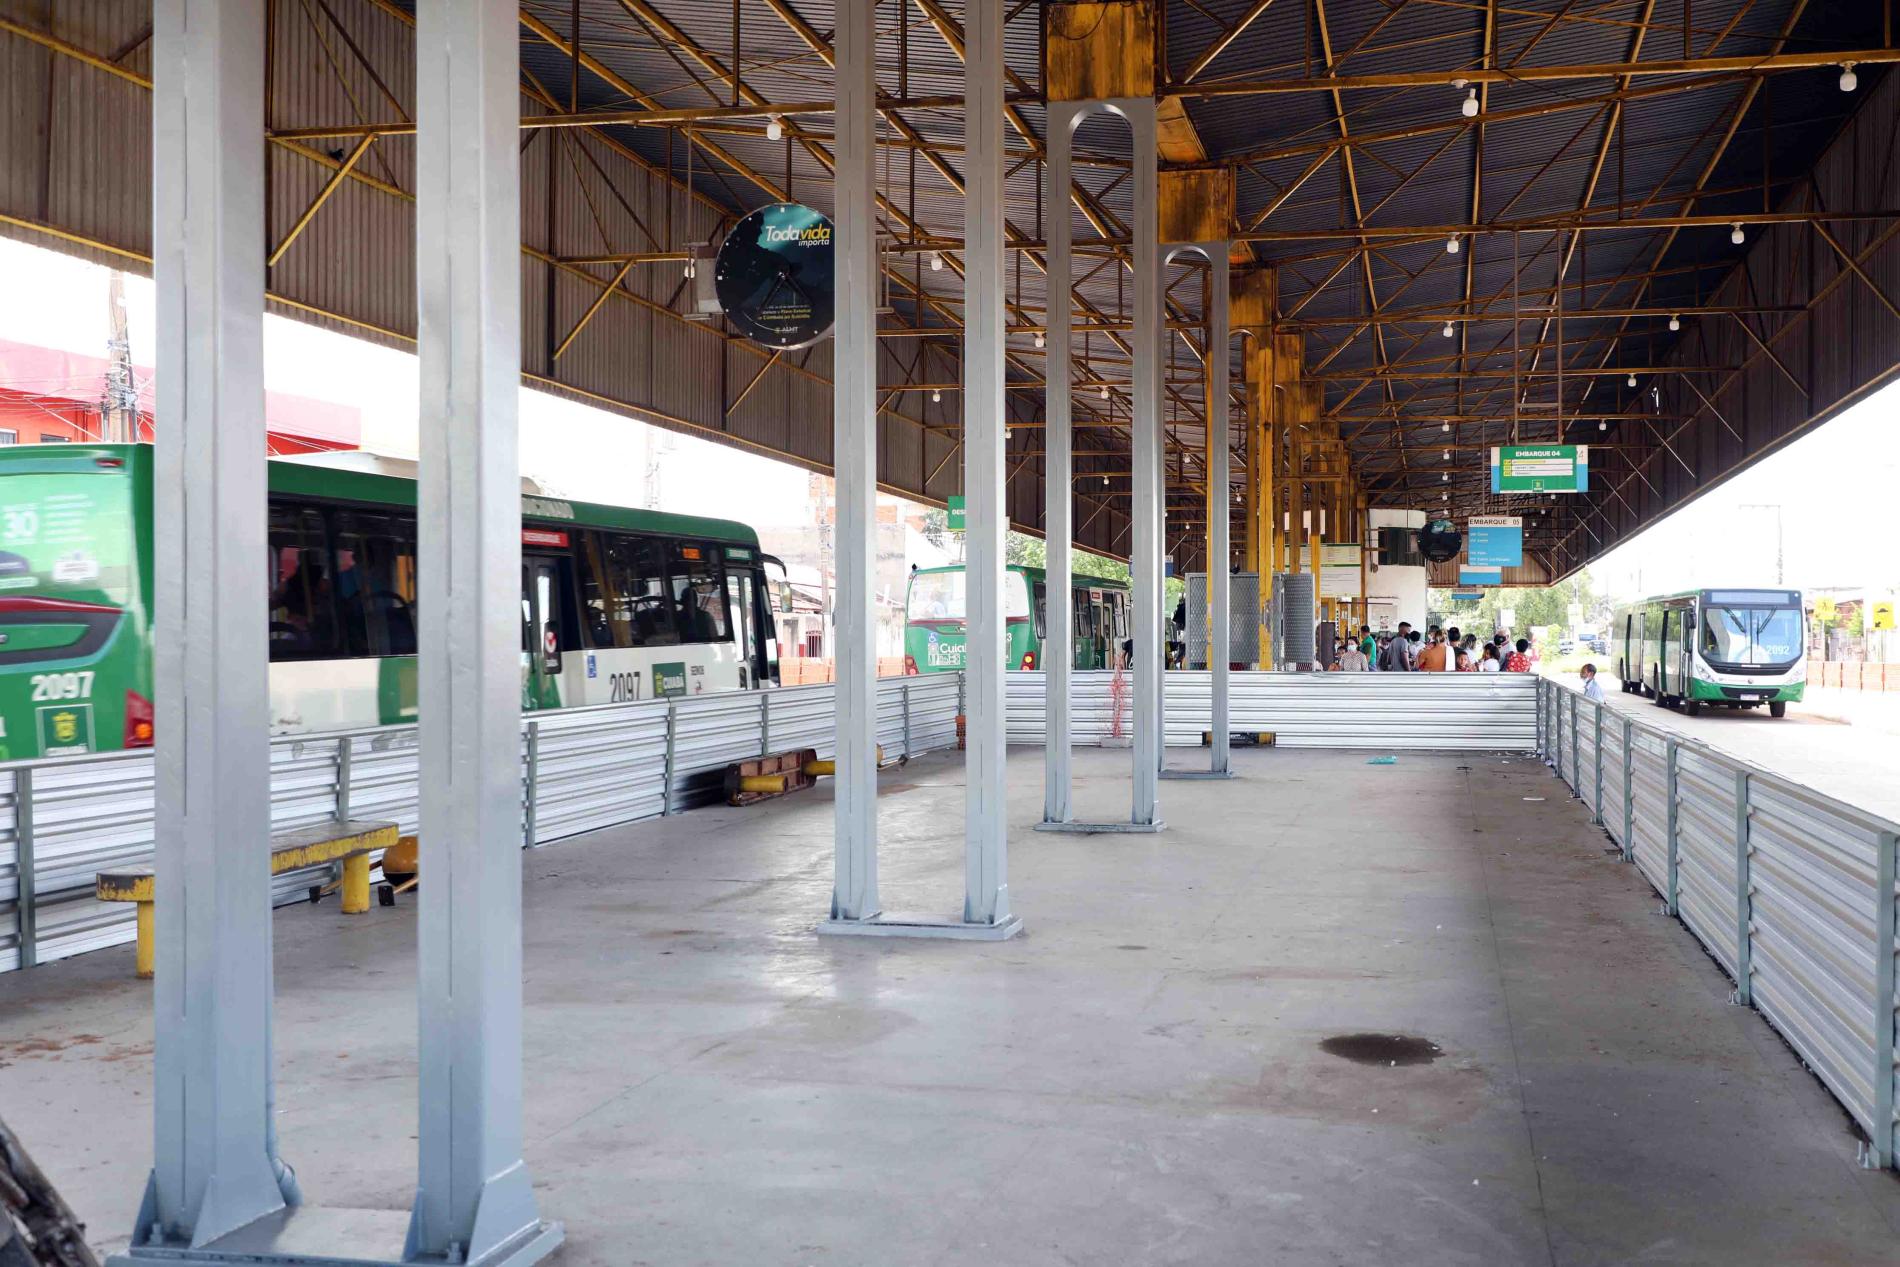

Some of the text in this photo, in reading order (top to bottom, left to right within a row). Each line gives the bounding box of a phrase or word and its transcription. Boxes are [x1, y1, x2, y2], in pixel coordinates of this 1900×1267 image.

[798, 239, 830, 248] importa
[1766, 645, 1790, 656] 2092
[30, 671, 96, 702] 2097
[609, 671, 641, 704] 2097
